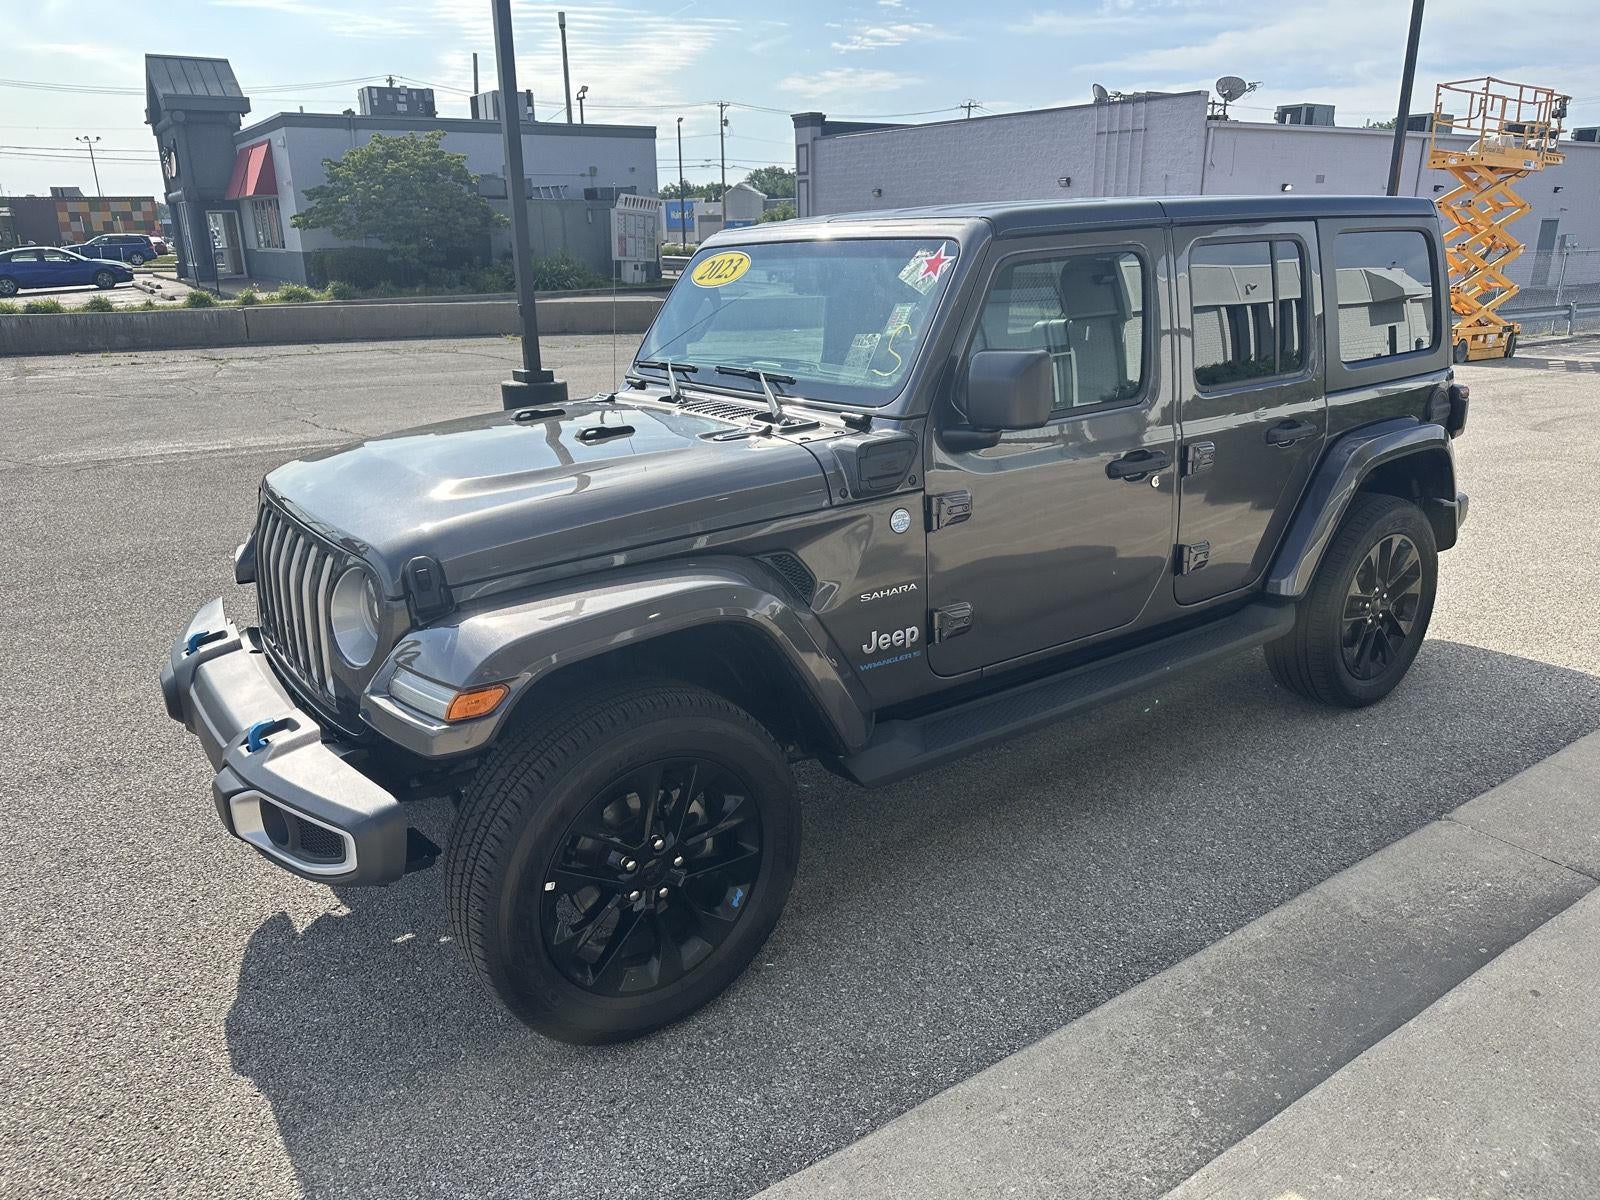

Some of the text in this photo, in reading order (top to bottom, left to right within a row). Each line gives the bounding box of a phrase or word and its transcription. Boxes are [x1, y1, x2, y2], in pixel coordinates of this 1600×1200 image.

[670, 208, 689, 220] Walmrt
[697, 257, 744, 281] 2023
[860, 583, 918, 602] SAHARA
[862, 626, 919, 654] Jeep
[860, 653, 912, 672] WRANGLER
